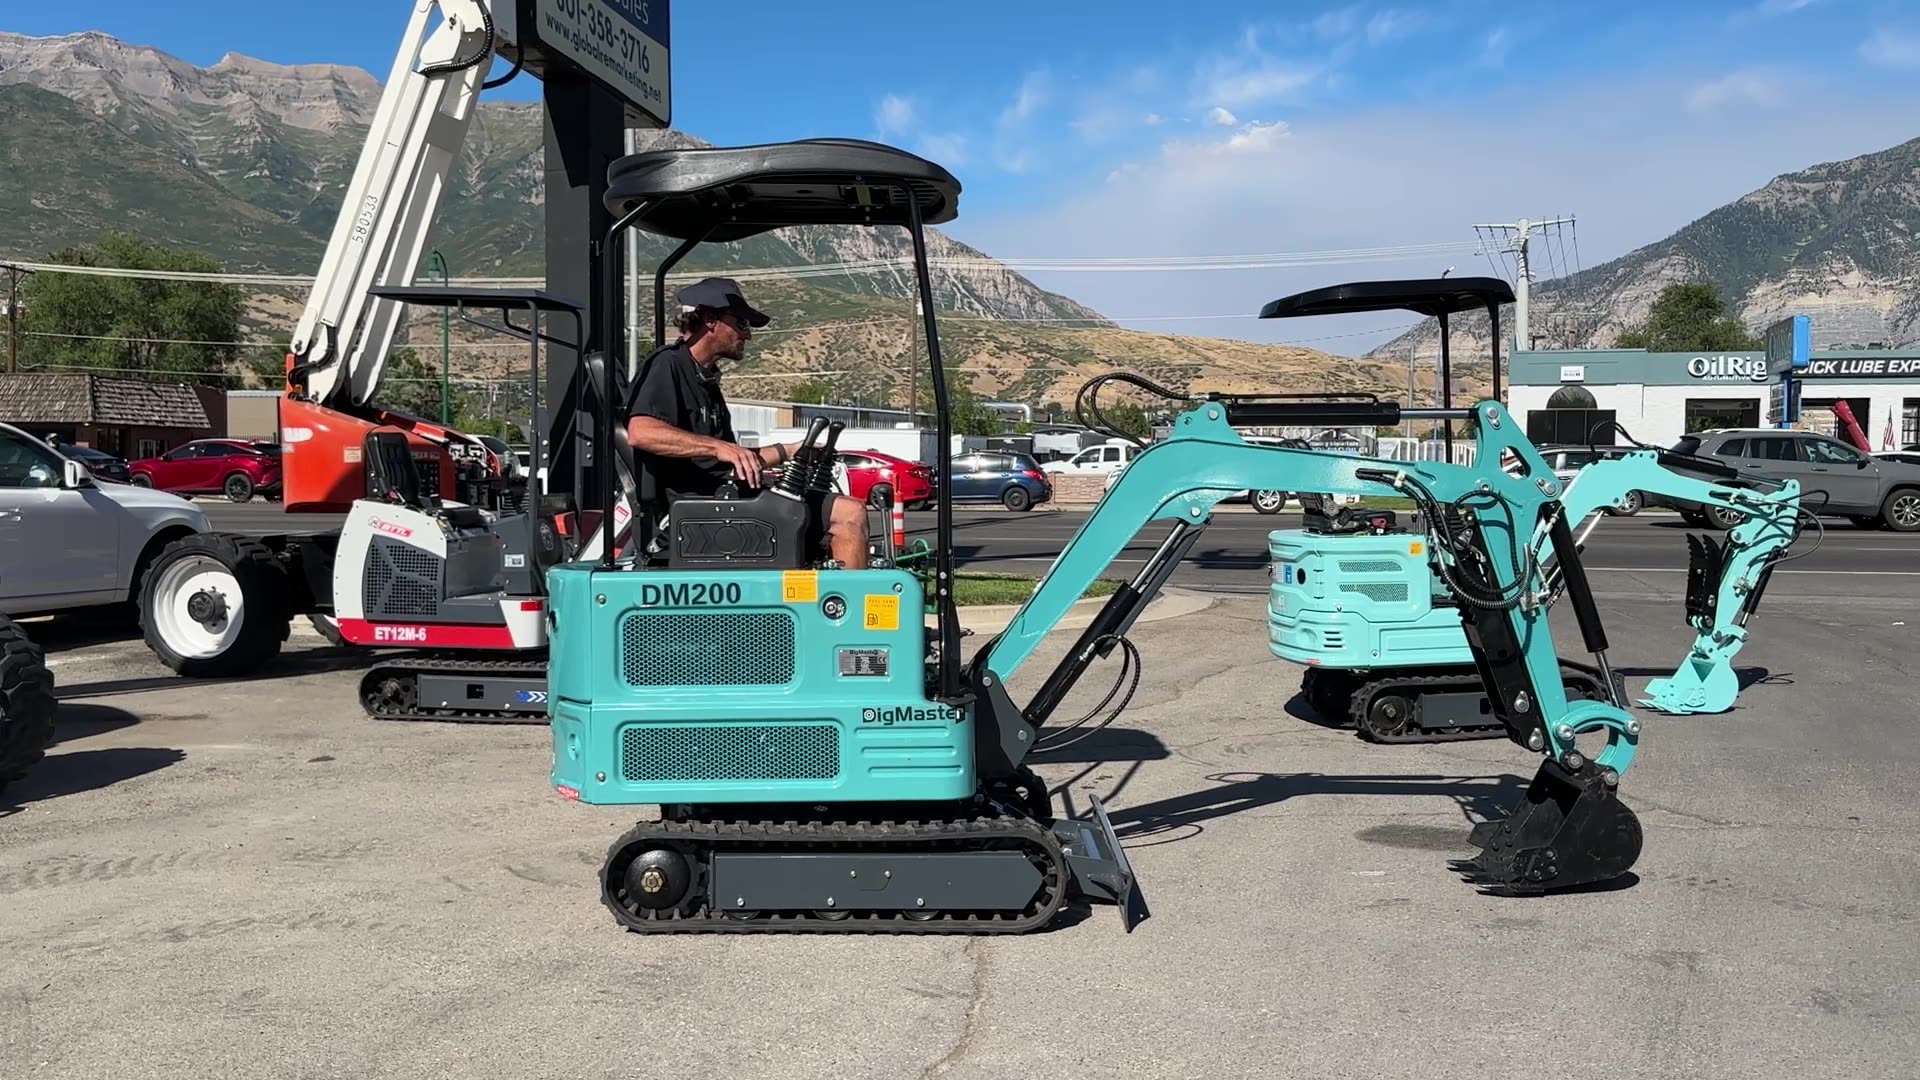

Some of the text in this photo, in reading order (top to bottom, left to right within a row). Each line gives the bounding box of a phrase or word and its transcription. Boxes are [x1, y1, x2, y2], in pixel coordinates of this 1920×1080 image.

[545, 11, 662, 104] www.globalremarketing.net
[352, 194, 378, 244] 580533
[1687, 355, 1768, 382] OilRig
[1793, 360, 1838, 374] ICK
[1840, 360, 1884, 374] LUBE
[641, 582, 742, 606] DM200
[374, 626, 427, 641] ET12M-6
[862, 705, 966, 725] DigMaster
